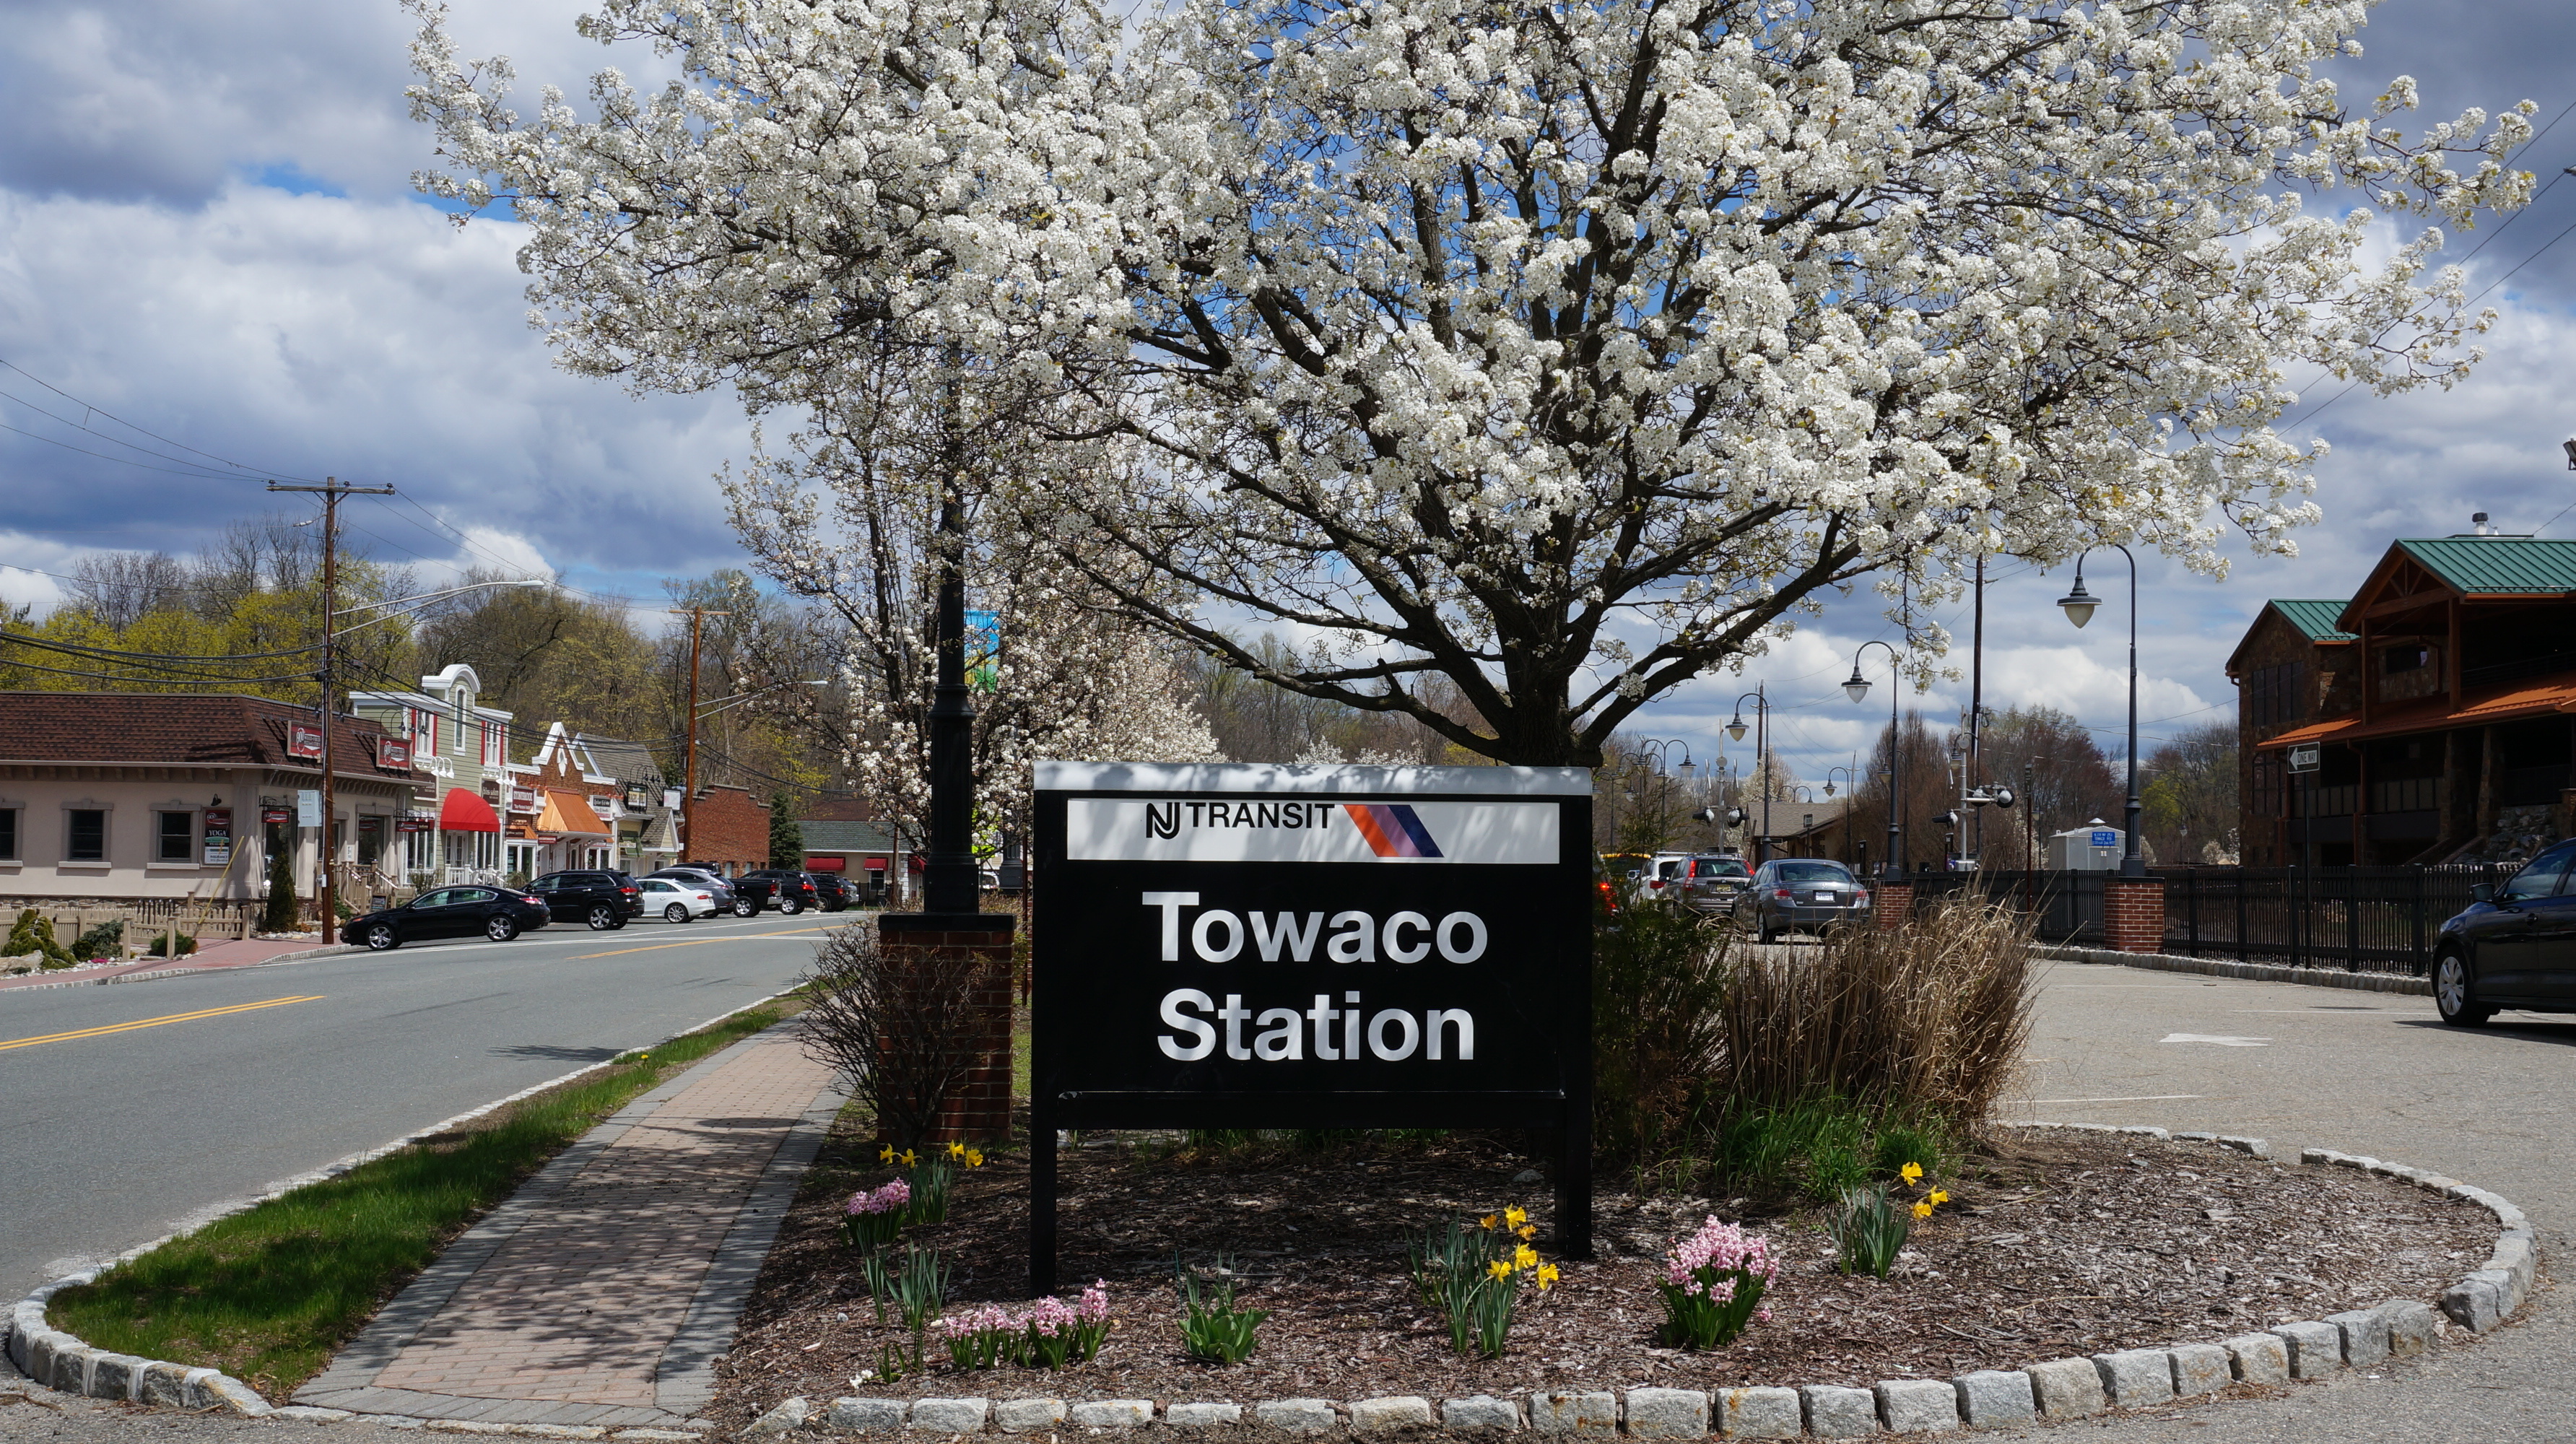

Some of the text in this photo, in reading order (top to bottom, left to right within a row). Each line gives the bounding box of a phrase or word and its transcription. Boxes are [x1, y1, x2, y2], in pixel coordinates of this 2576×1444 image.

[2297, 752, 2316, 764] ONE WAY
[1146, 801, 1335, 840] NJ TRANSIT
[1142, 892, 1487, 964] Towaco
[1157, 988, 1474, 1061] Station
